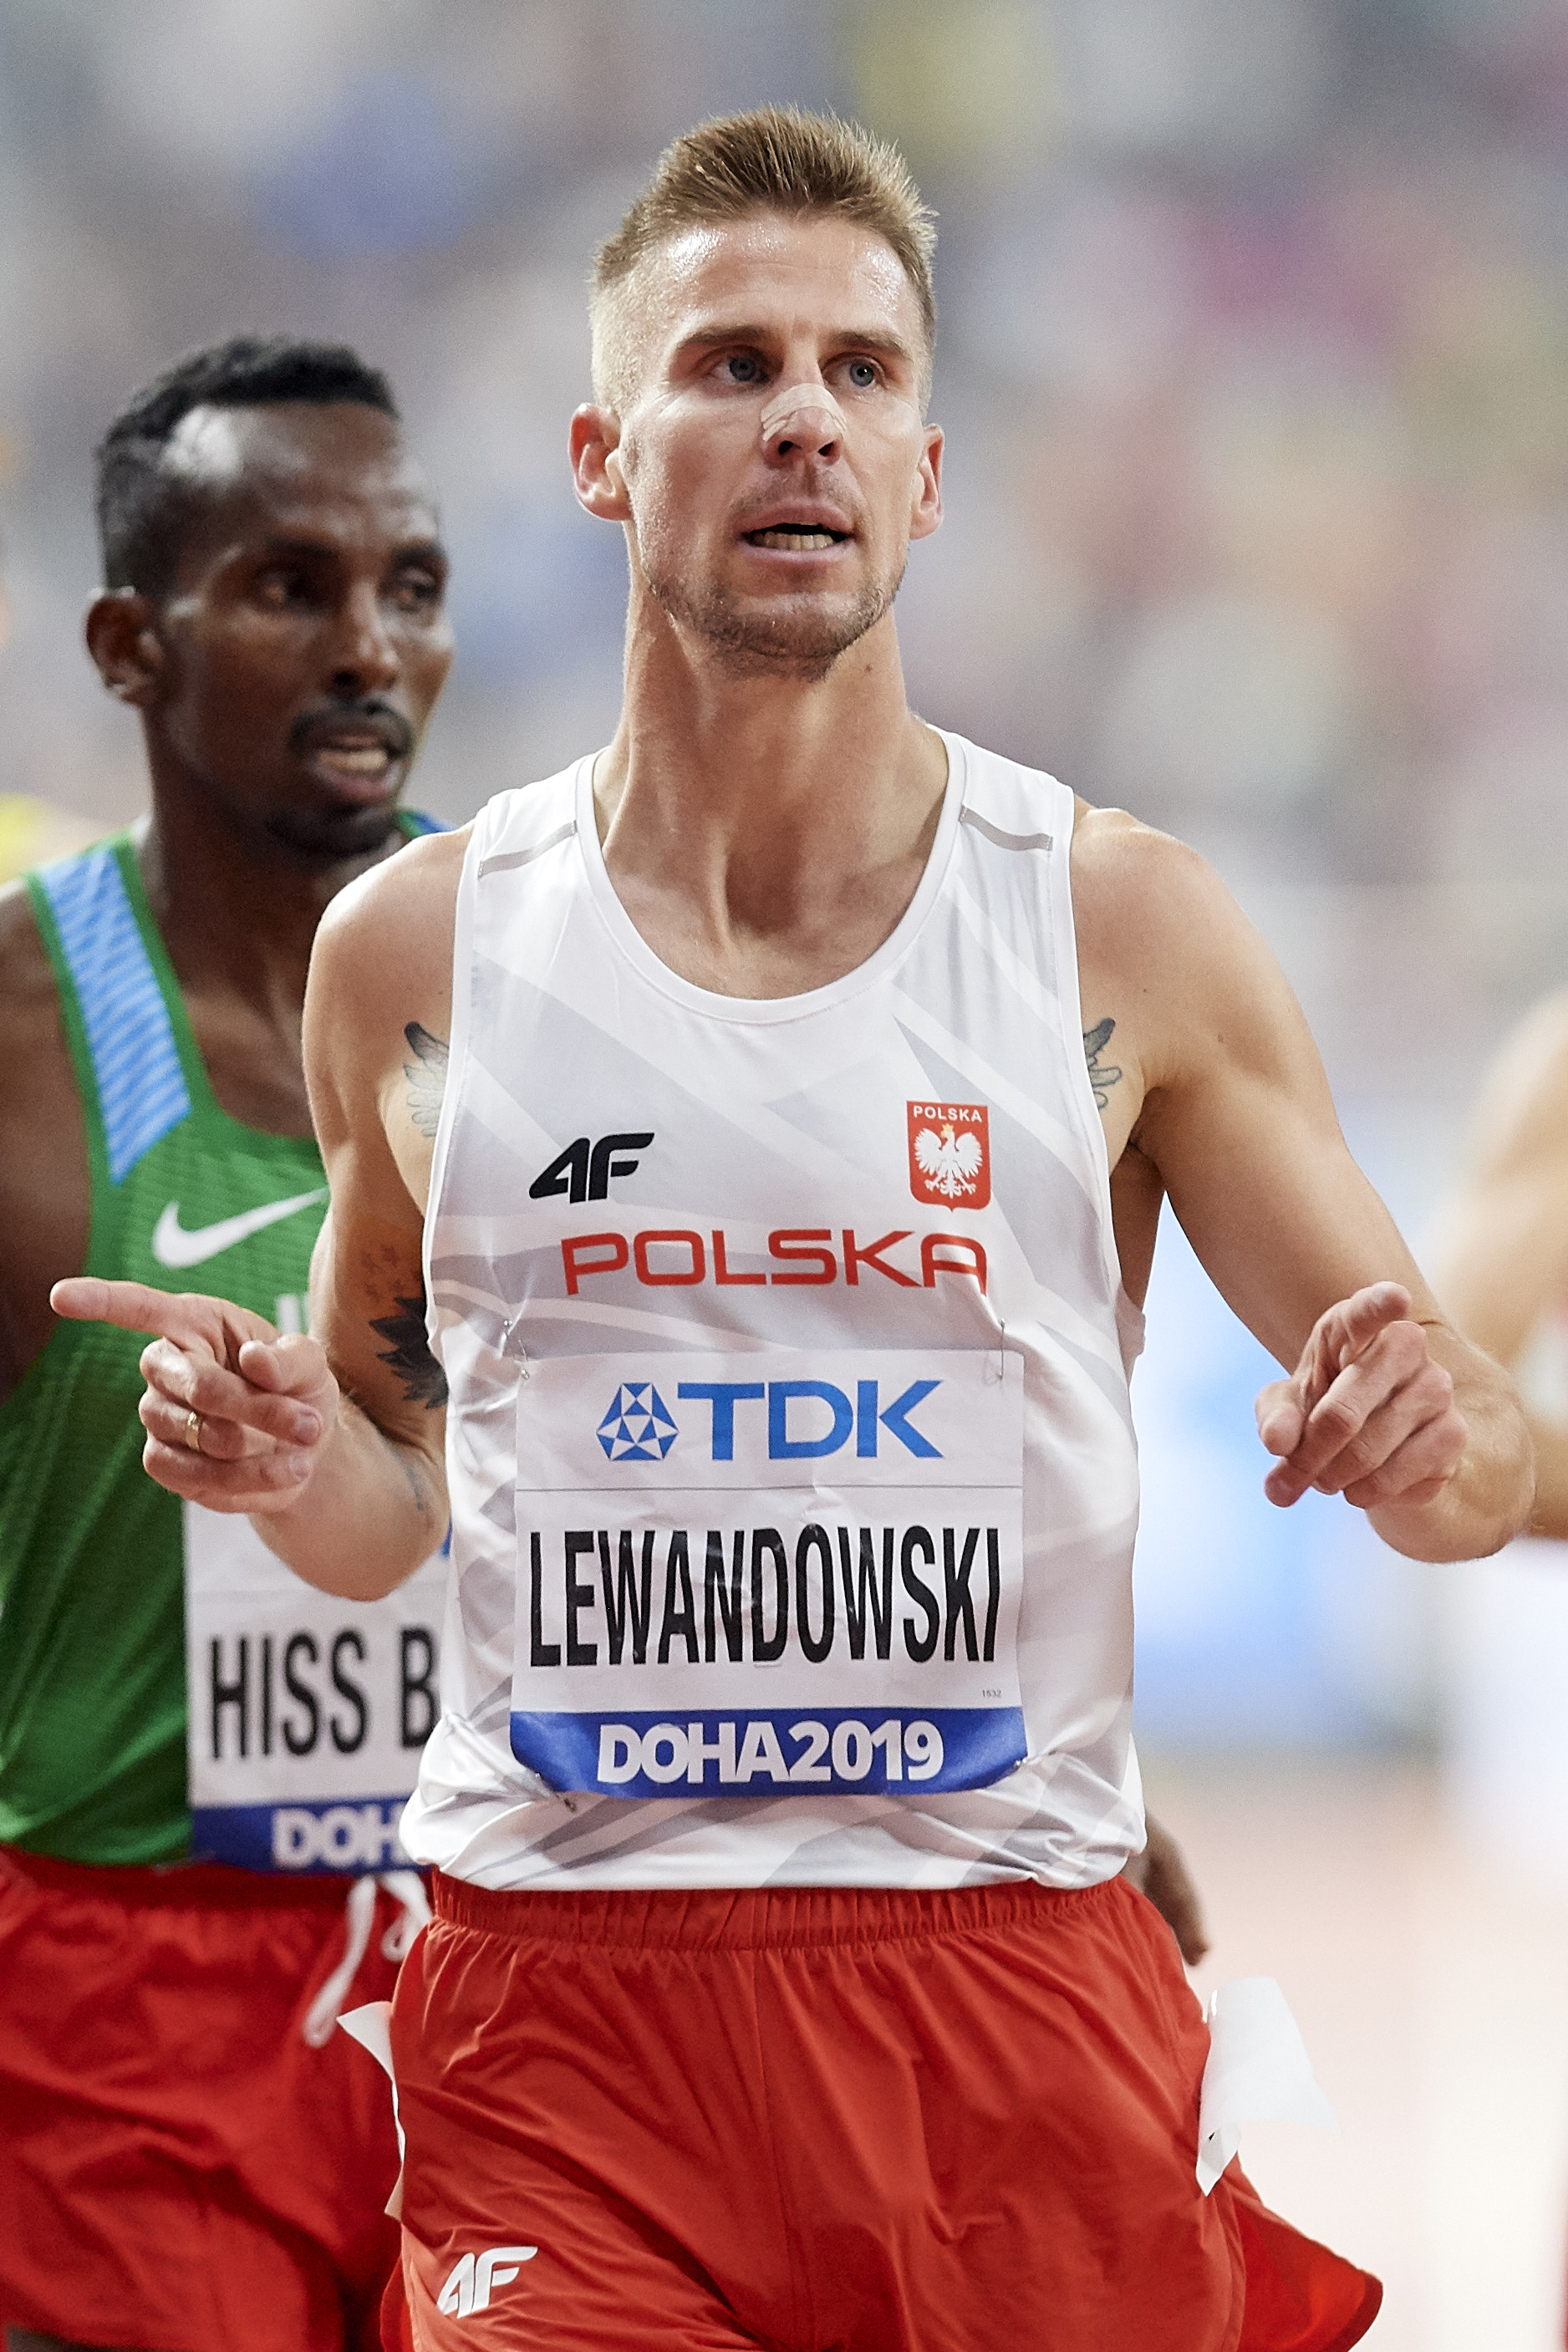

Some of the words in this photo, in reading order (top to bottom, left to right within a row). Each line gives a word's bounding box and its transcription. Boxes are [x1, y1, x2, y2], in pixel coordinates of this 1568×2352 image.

[913, 1105, 982, 1123] POLSKA
[529, 1133, 654, 1204] 4F
[561, 1229, 987, 1296] POLSKA
[677, 1380, 944, 1460] TDK
[529, 1524, 1000, 1667] LEWANDOWSKI
[210, 1630, 367, 1761] HISS
[597, 1719, 944, 1784] DOHA2019
